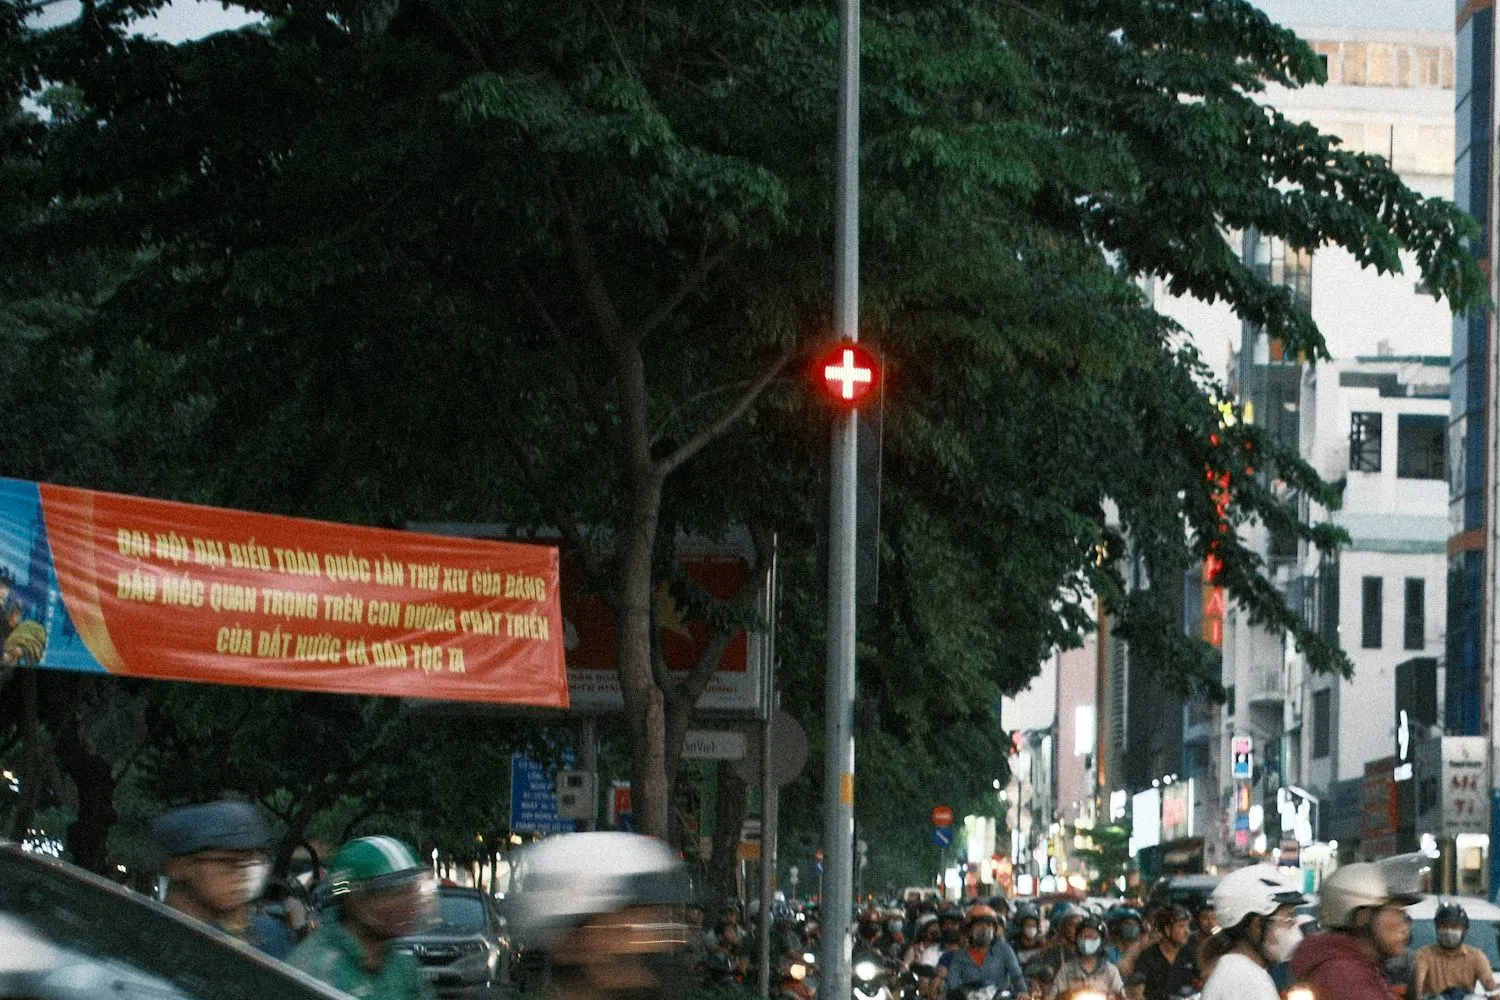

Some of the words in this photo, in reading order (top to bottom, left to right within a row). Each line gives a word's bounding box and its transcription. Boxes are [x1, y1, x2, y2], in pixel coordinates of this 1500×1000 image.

[156, 530, 188, 566] HỘI
[193, 538, 225, 570] ĐẠI
[229, 536, 271, 570] BIỂU
[274, 546, 321, 577] TOÀN
[324, 549, 370, 583] QUỐC
[375, 553, 404, 586] LẦN
[443, 568, 468, 593] XIV
[472, 566, 501, 597] CỦA
[504, 571, 546, 601] ĐẢNG
[162, 571, 204, 607] MỐC
[210, 582, 257, 612] QUAN
[262, 588, 318, 621] TRỌNG
[324, 593, 363, 623] TRÊN
[368, 600, 400, 627] CON
[460, 607, 501, 636] PHÁT
[505, 607, 549, 641] TRIỂN
[216, 622, 252, 655] CỦA
[258, 623, 292, 659] ĐẤT
[295, 633, 340, 664] NƯỚC
[346, 635, 369, 665] VÀ
[372, 639, 407, 668] DÂN
[411, 642, 443, 676] TỘC
[448, 648, 465, 674] TA
